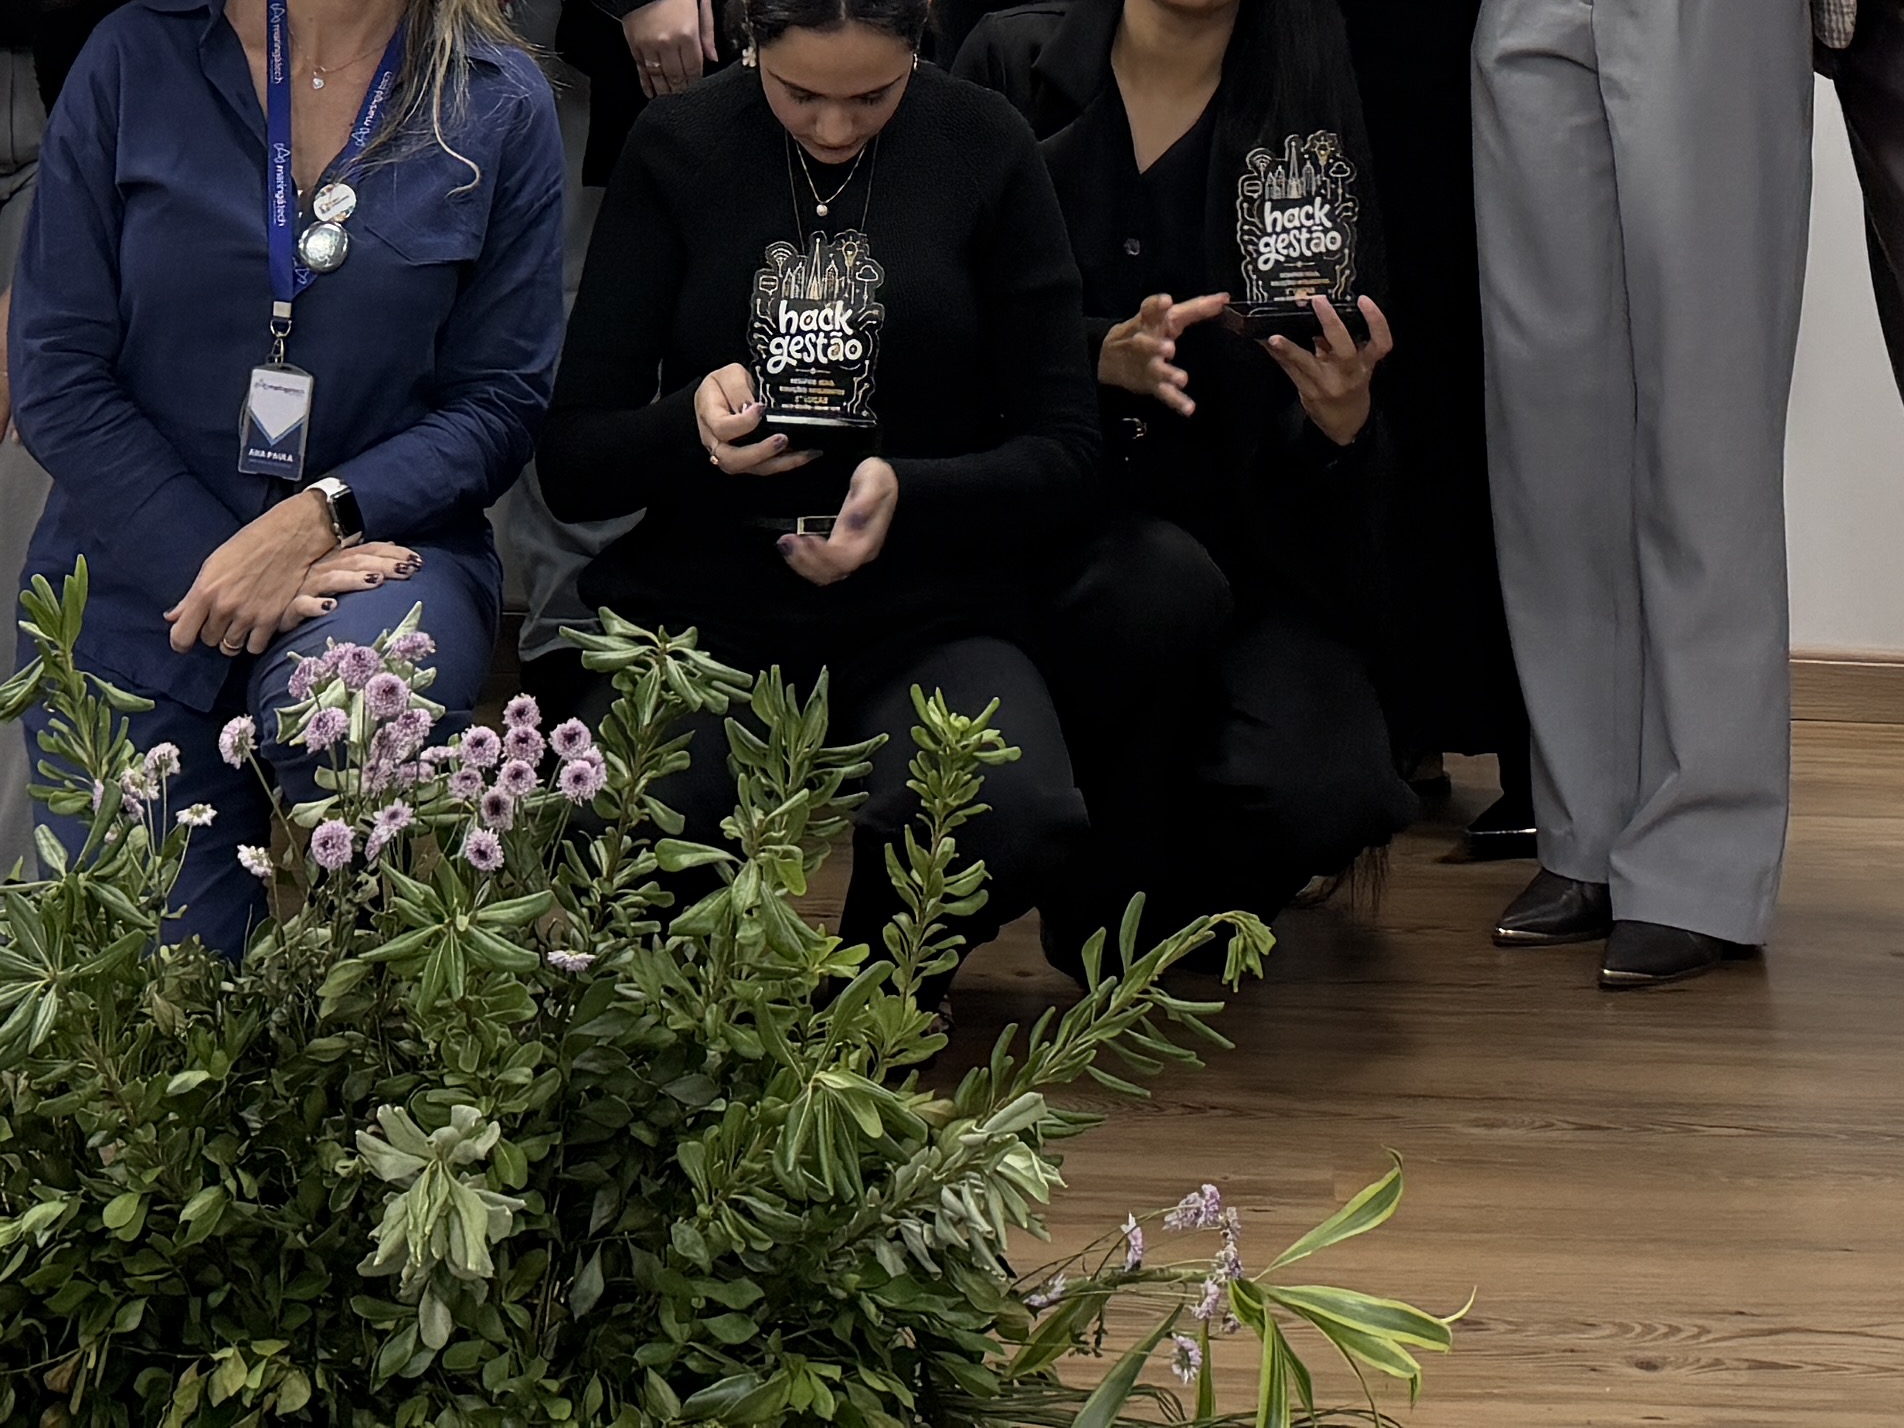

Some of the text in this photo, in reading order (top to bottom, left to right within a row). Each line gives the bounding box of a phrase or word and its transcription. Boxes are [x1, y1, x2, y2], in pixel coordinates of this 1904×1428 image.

[1263, 196, 1333, 233] hack
[1257, 225, 1342, 271] gestão
[778, 299, 854, 335] hack
[766, 331, 863, 375] gestão
[248, 448, 294, 463] ANA PAULA
